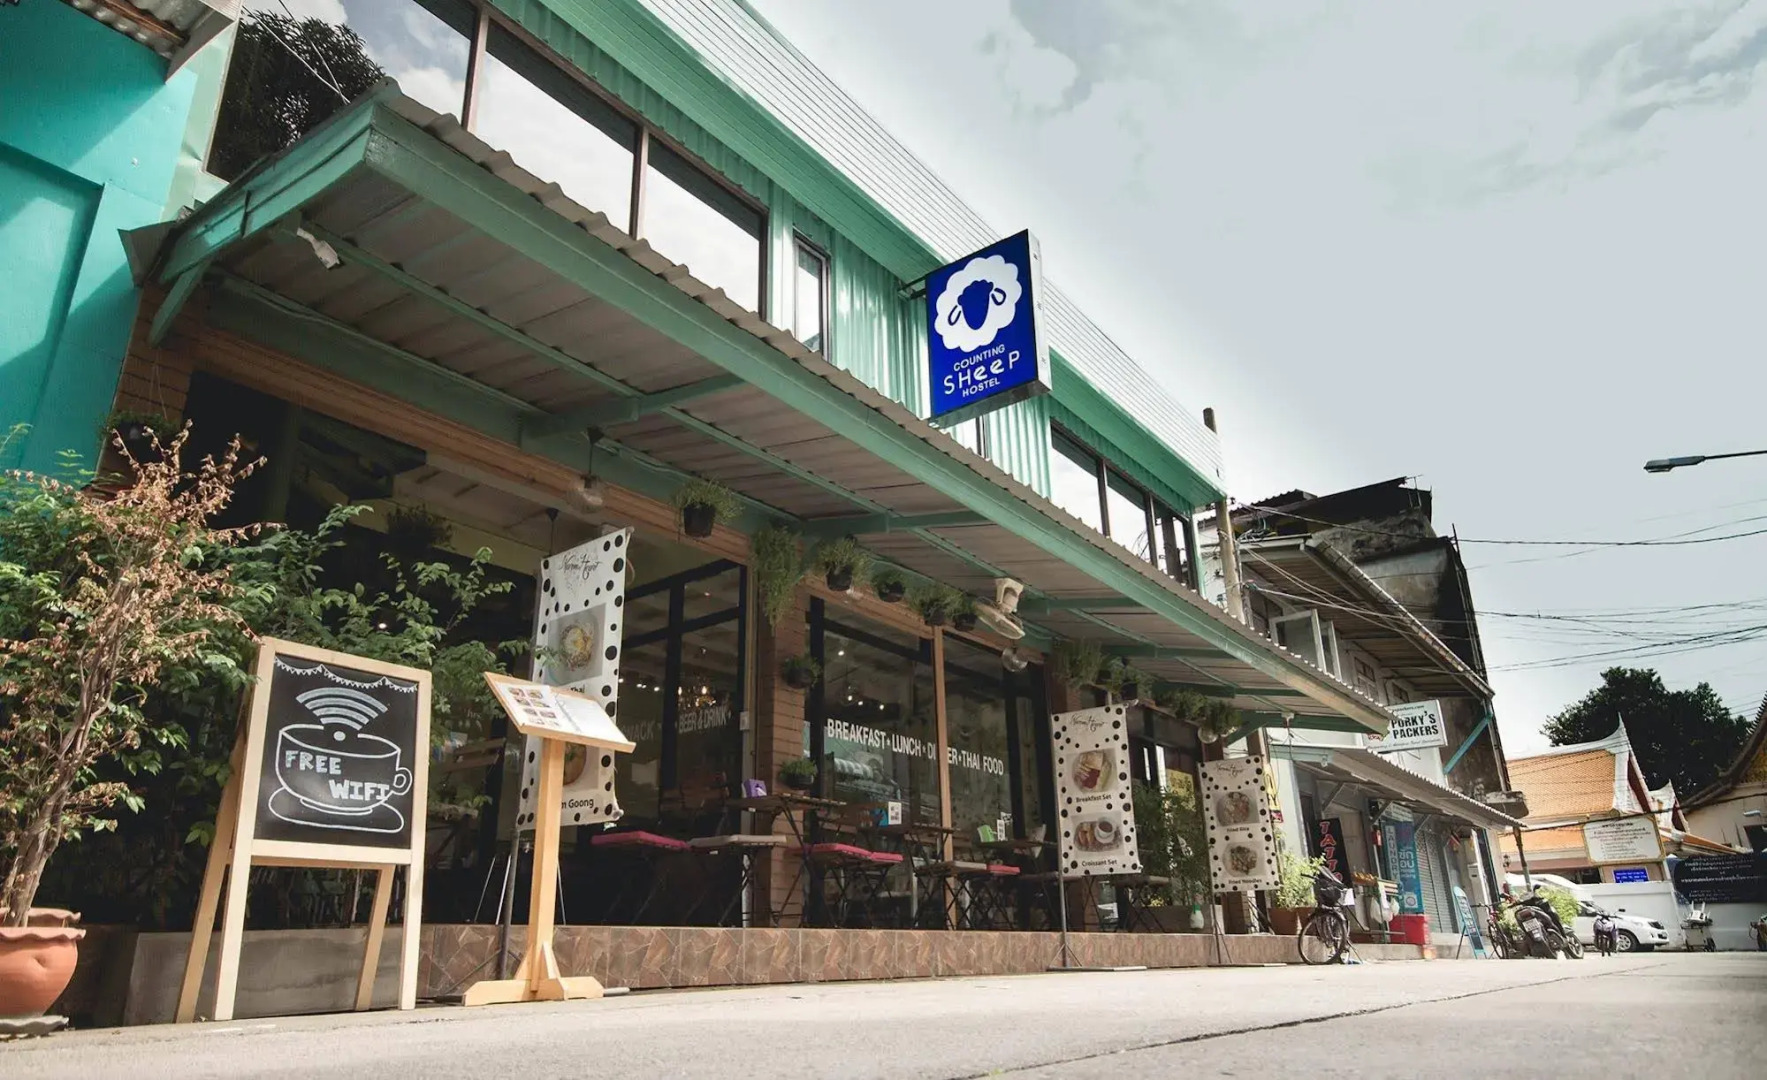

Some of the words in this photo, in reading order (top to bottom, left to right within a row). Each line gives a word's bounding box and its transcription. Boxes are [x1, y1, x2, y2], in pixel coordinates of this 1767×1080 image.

[953, 344, 1005, 371] COUNTING
[962, 377, 1000, 397] HOSTEL
[679, 712, 697, 734] BEER
[704, 706, 727, 729] DRINK
[1391, 710, 1437, 728] PORKY'S
[1392, 725, 1439, 739] PACKERS
[826, 718, 887, 750] BREAKFAST
[892, 734, 922, 757] LUNCH
[927, 742, 959, 765] DIER
[961, 750, 981, 770] THAI
[983, 756, 1004, 776] FOOD
[285, 750, 342, 774] FREE
[328, 779, 390, 801] WIFI
[1075, 795, 1102, 803] Breakfast
[568, 799, 594, 810] Goong
[1081, 859, 1107, 867] Croissant
[1387, 826, 1398, 880] LAUNDRY
